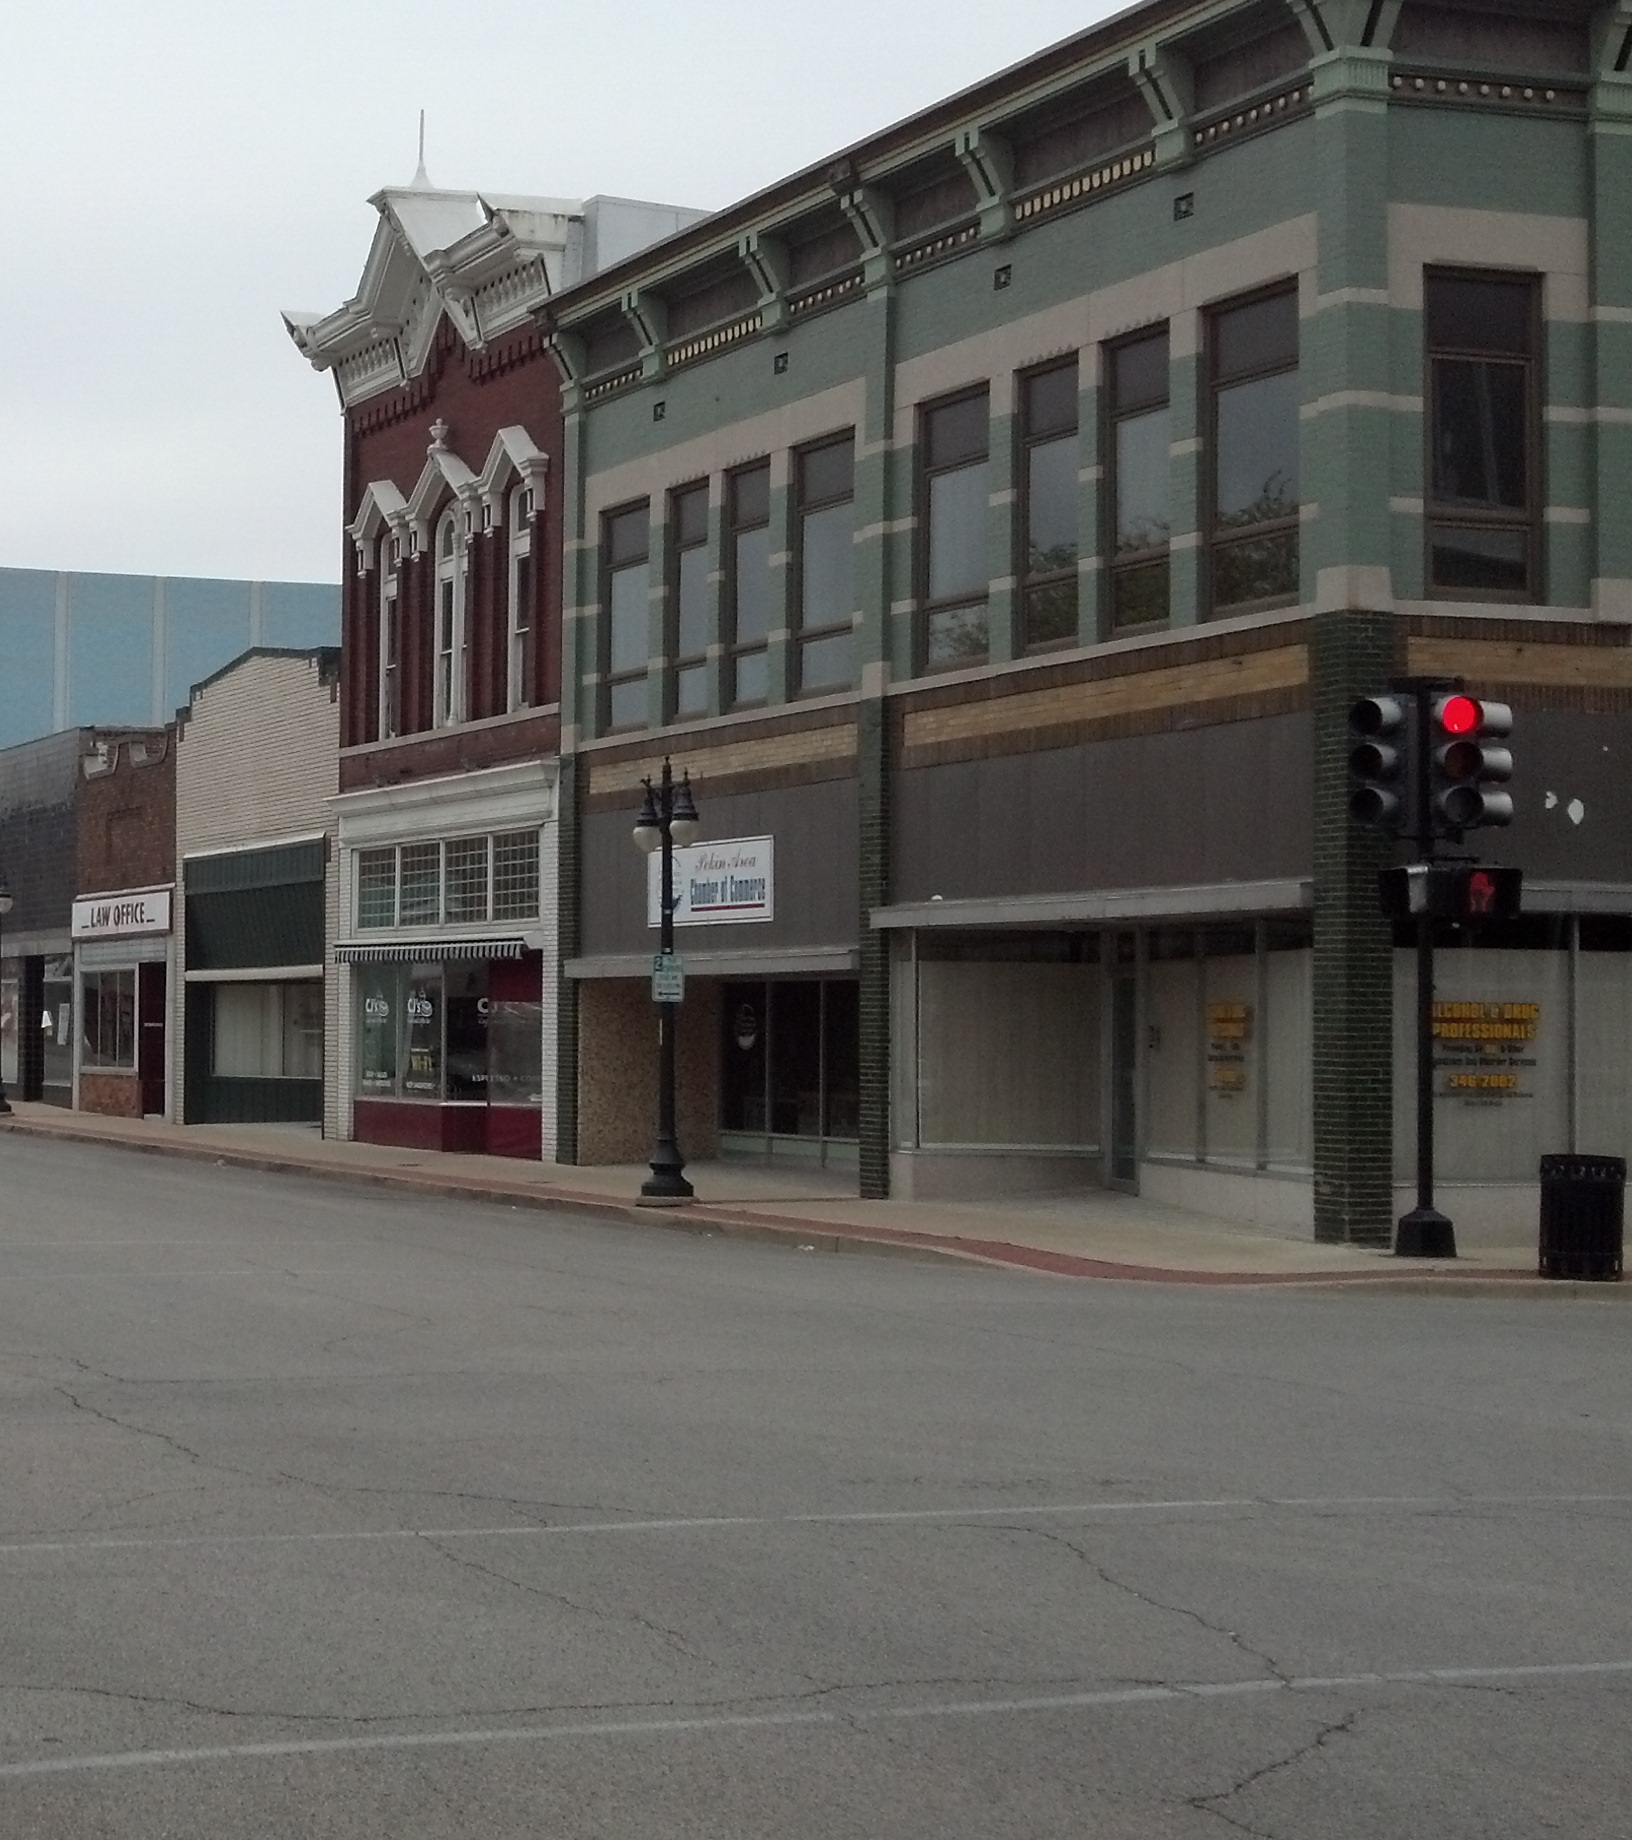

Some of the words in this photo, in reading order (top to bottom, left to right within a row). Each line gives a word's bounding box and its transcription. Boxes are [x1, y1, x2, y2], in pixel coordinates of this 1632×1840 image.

[690, 877, 718, 905] Chamber
[90, 906, 111, 928] LAW
[113, 902, 145, 926] OFFICE
[1432, 1022, 1537, 1038] PROFESSIONALS
